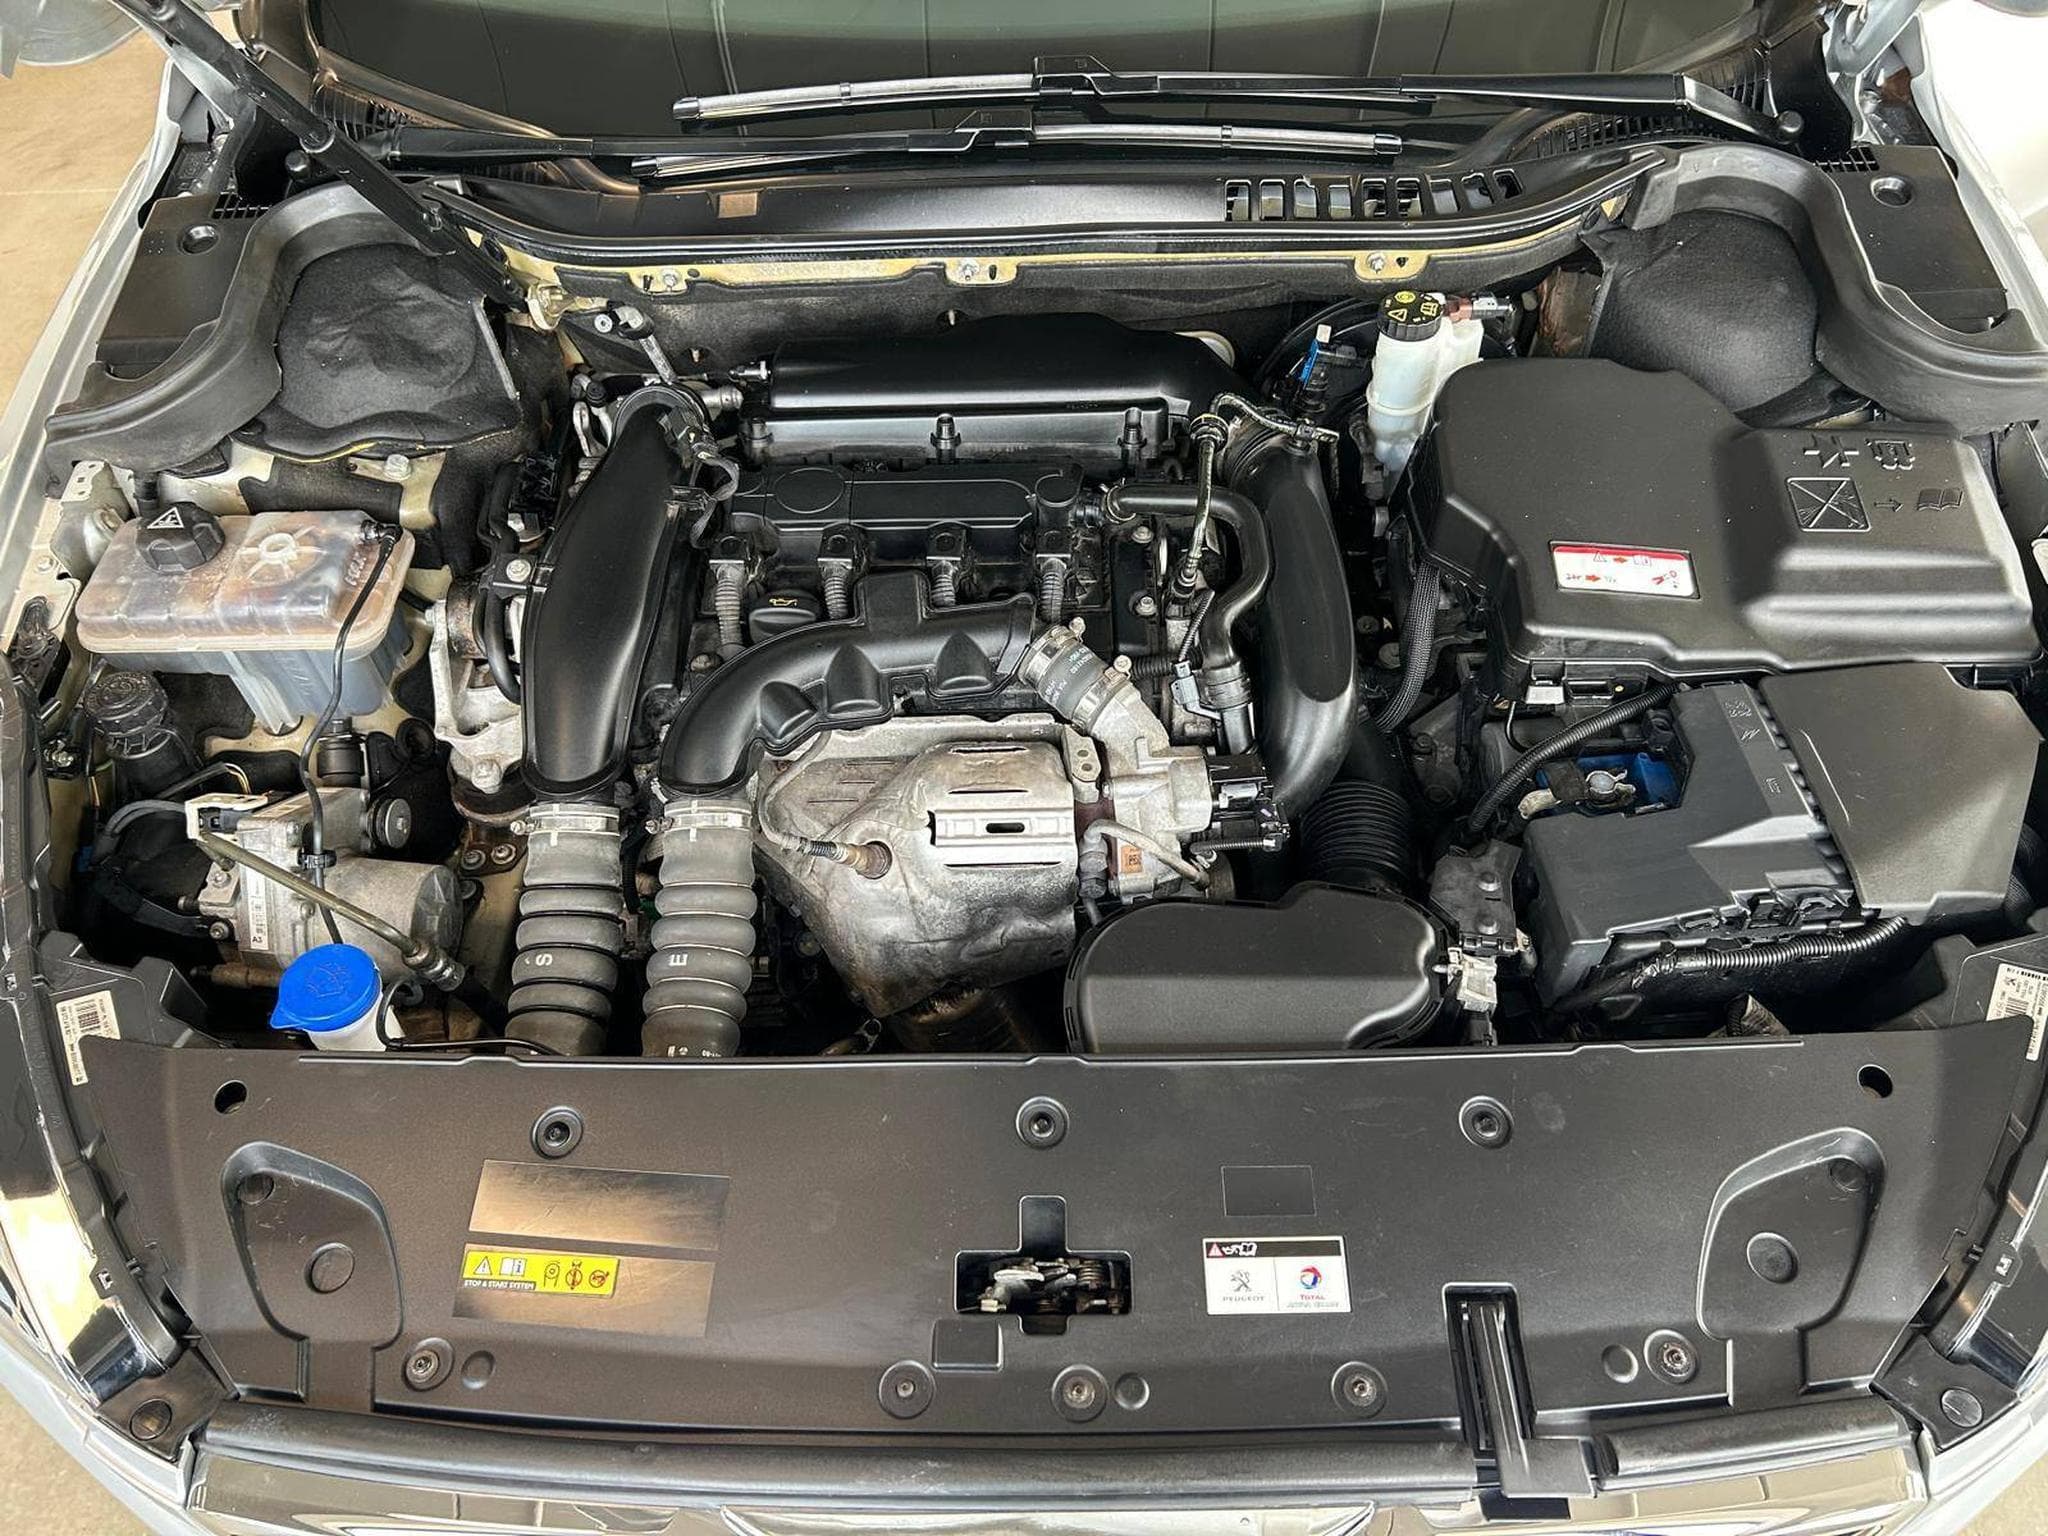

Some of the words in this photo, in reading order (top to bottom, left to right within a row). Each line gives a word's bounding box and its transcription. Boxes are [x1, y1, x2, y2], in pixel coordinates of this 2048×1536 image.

[536, 953, 553, 966] S
[669, 953, 688, 966] E
[464, 1280, 482, 1288] STOP
[488, 1281, 508, 1289] START
[509, 1282, 535, 1290] SYSTEM
